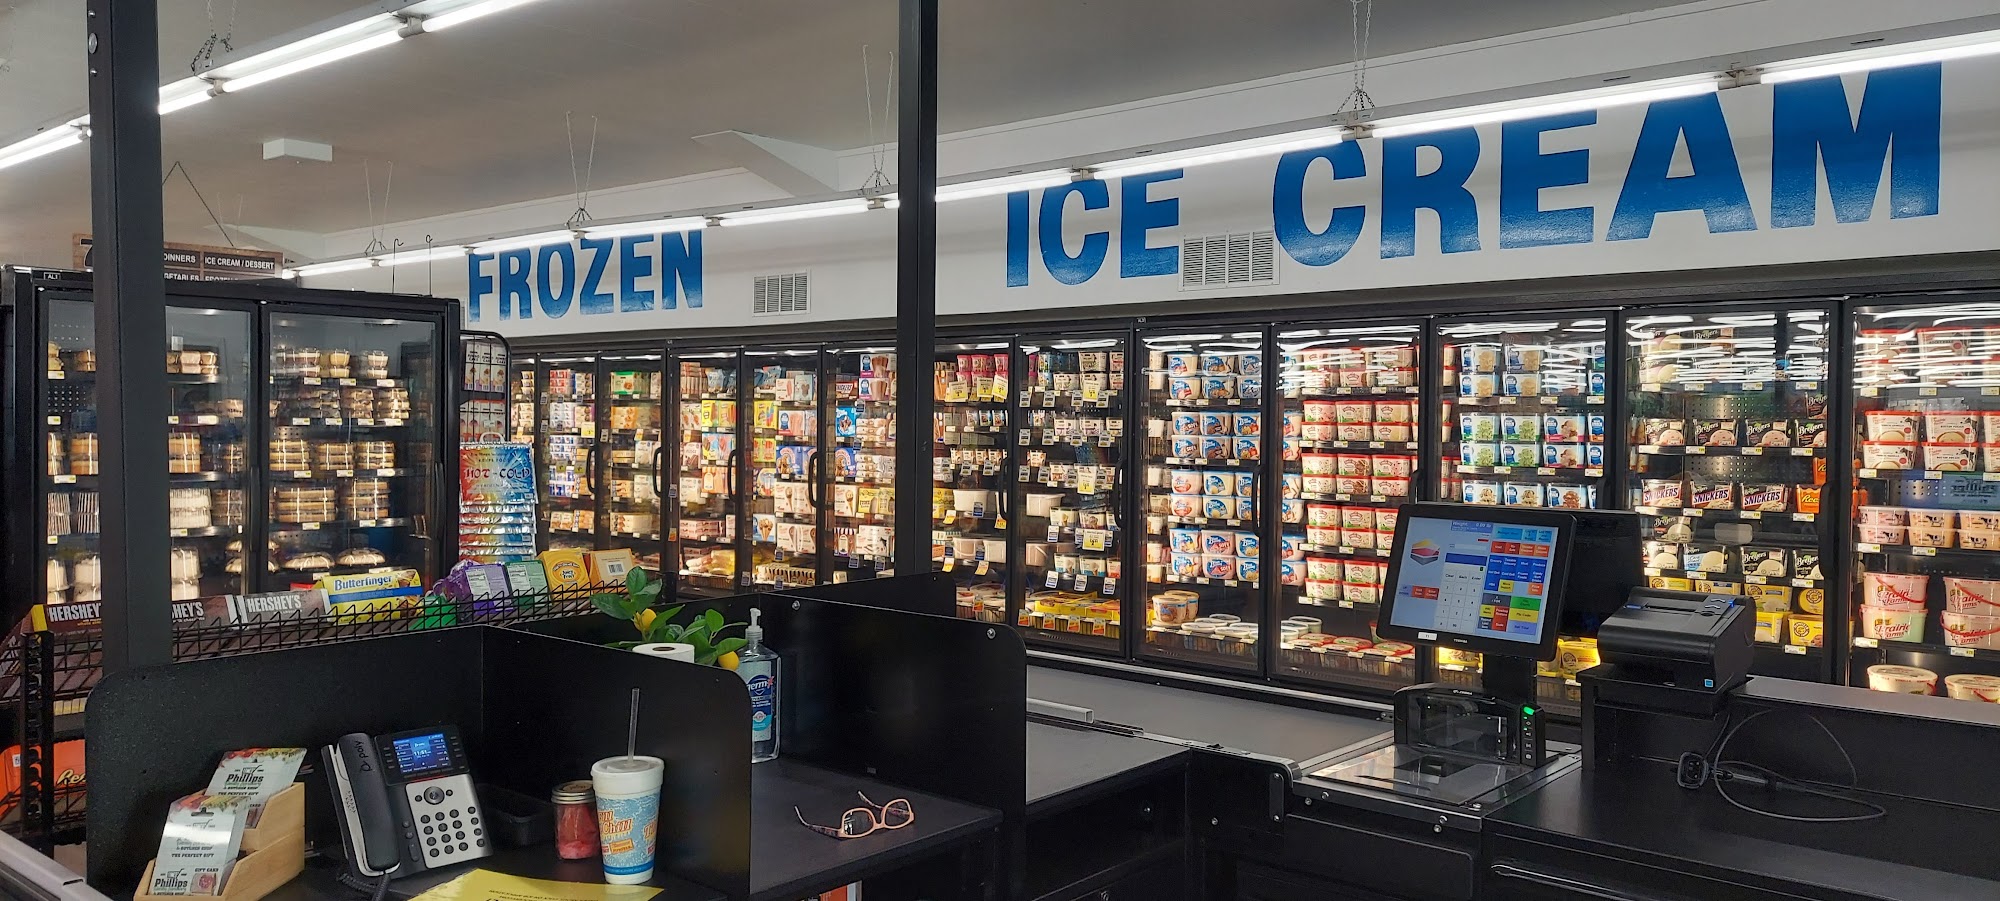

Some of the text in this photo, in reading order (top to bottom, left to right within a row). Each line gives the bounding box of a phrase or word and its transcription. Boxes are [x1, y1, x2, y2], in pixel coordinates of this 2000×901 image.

[1006, 62, 1941, 288] ICE CREAM
[204, 256, 216, 265] ICE
[217, 257, 241, 267] CREAM
[245, 259, 275, 270] DESSERT
[468, 229, 704, 323] FROZEN
[1645, 421, 1668, 435] Breyers
[1696, 421, 1719, 435] Breyers
[1748, 422, 1770, 436] Breyers
[1799, 422, 1824, 436] Breyers
[499, 468, 531, 479] COLD
[1644, 487, 1679, 502] SNICKERS
[1693, 489, 1729, 503] SNICKERS
[1744, 491, 1781, 506] SNICKERS
[1654, 517, 1677, 527] Breyers
[1743, 551, 1767, 562] Breyers
[333, 575, 393, 591] Butterfinger
[171, 601, 204, 619] HEY'S
[247, 594, 302, 613] HERSHEY'S
[50, 603, 102, 623] HERSHEY'
[354, 740, 369, 759] poly
[226, 773, 265, 784] Phillips
[154, 878, 188, 888] Phillips
